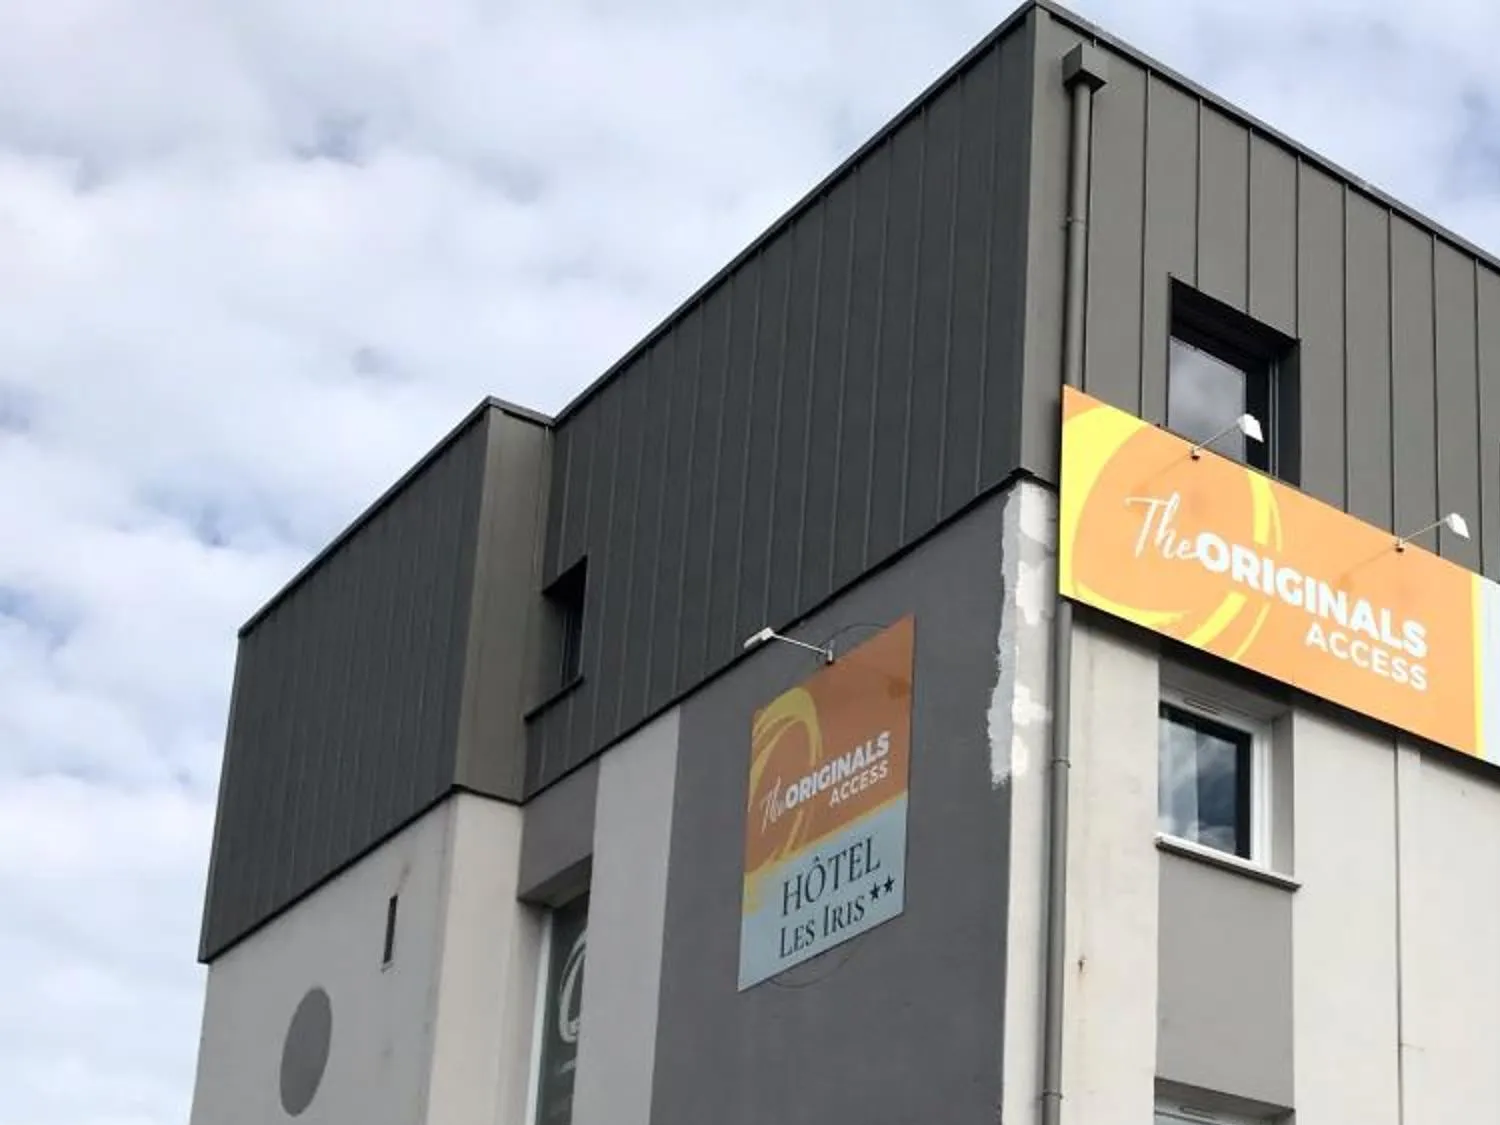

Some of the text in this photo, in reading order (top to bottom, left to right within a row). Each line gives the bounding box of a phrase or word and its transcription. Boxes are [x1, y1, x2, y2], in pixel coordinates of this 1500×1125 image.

[1196, 531, 1428, 659] ORIGINALS
[1305, 622, 1428, 691] ACCESS
[785, 731, 891, 809] ORIGINALS
[829, 760, 889, 808] ACCESS
[781, 836, 881, 917] HÔTEL
